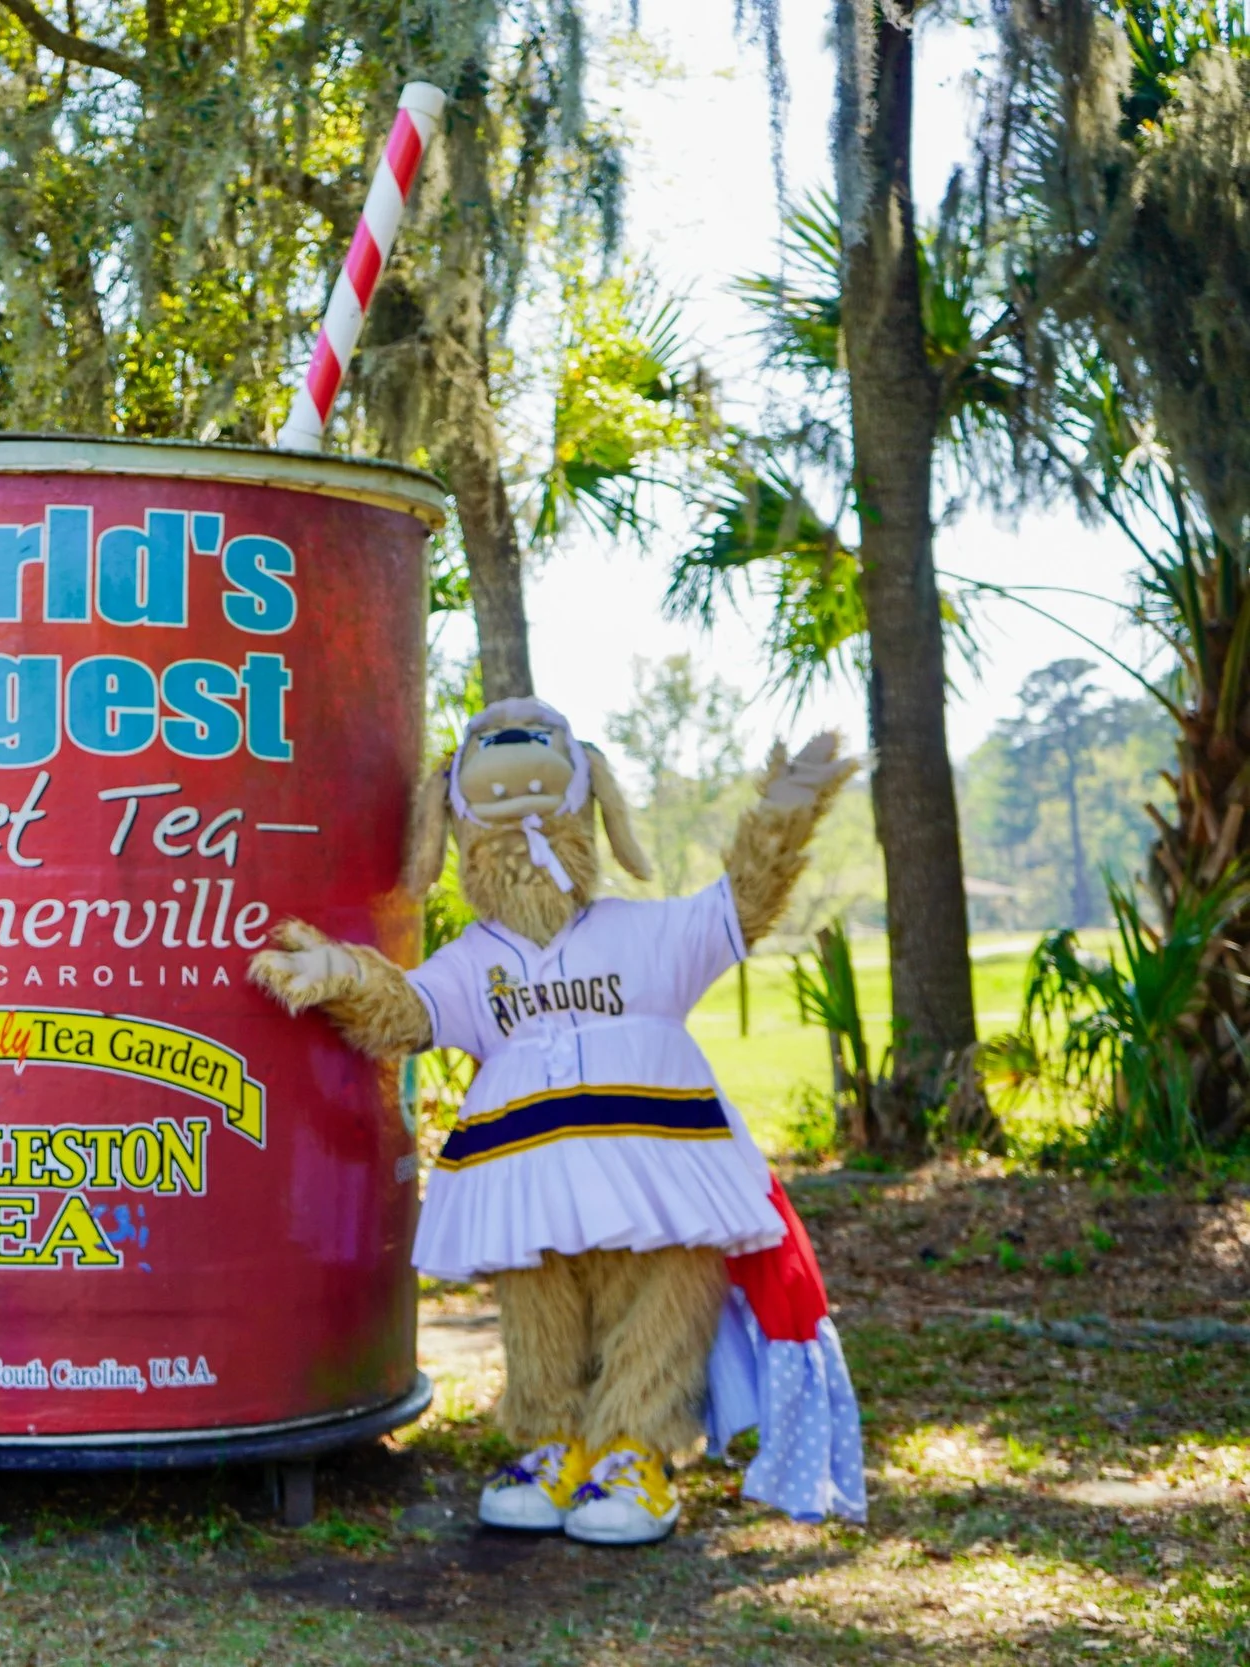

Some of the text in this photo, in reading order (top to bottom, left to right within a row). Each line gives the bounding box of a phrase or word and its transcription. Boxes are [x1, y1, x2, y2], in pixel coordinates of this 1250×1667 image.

[98, 783, 244, 867] Tea
[34, 1019, 95, 1057] Tea
[110, 1028, 229, 1092] Garden
[50, 1359, 147, 1393] Carolina,
[148, 1356, 217, 1388] U.S.A.
